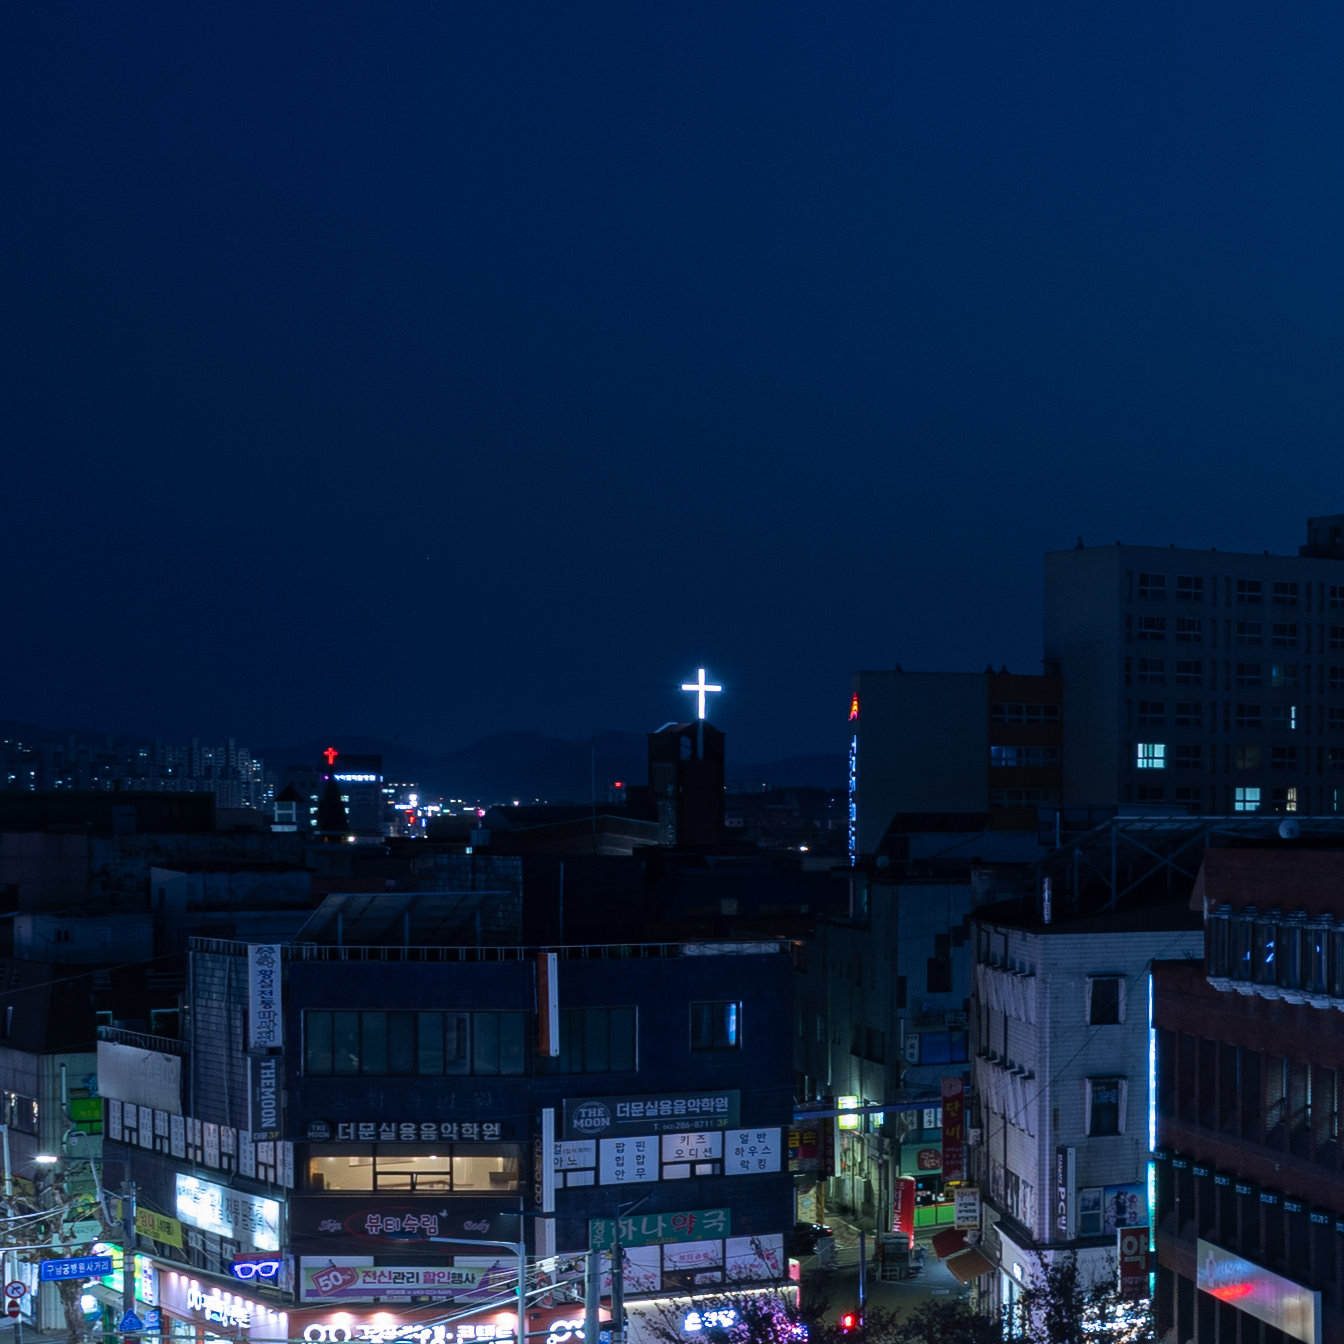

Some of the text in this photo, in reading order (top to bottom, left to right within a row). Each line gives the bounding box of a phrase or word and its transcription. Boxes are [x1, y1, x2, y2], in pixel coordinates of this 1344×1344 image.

[580, 1108, 604, 1118] THE
[617, 1097, 728, 1118] 더문실용음악학원
[573, 1117, 610, 1129] MOON
[946, 1101, 962, 1140] 단비
[307, 1131, 330, 1139] MOON
[337, 1122, 501, 1141] 더문실용음악학원
[674, 1147, 713, 1159] 오디션
[734, 1145, 771, 1157] 하우스
[1122, 1234, 1149, 1270] 약
[361, 1270, 476, 1284] 전신관리 할인행사
